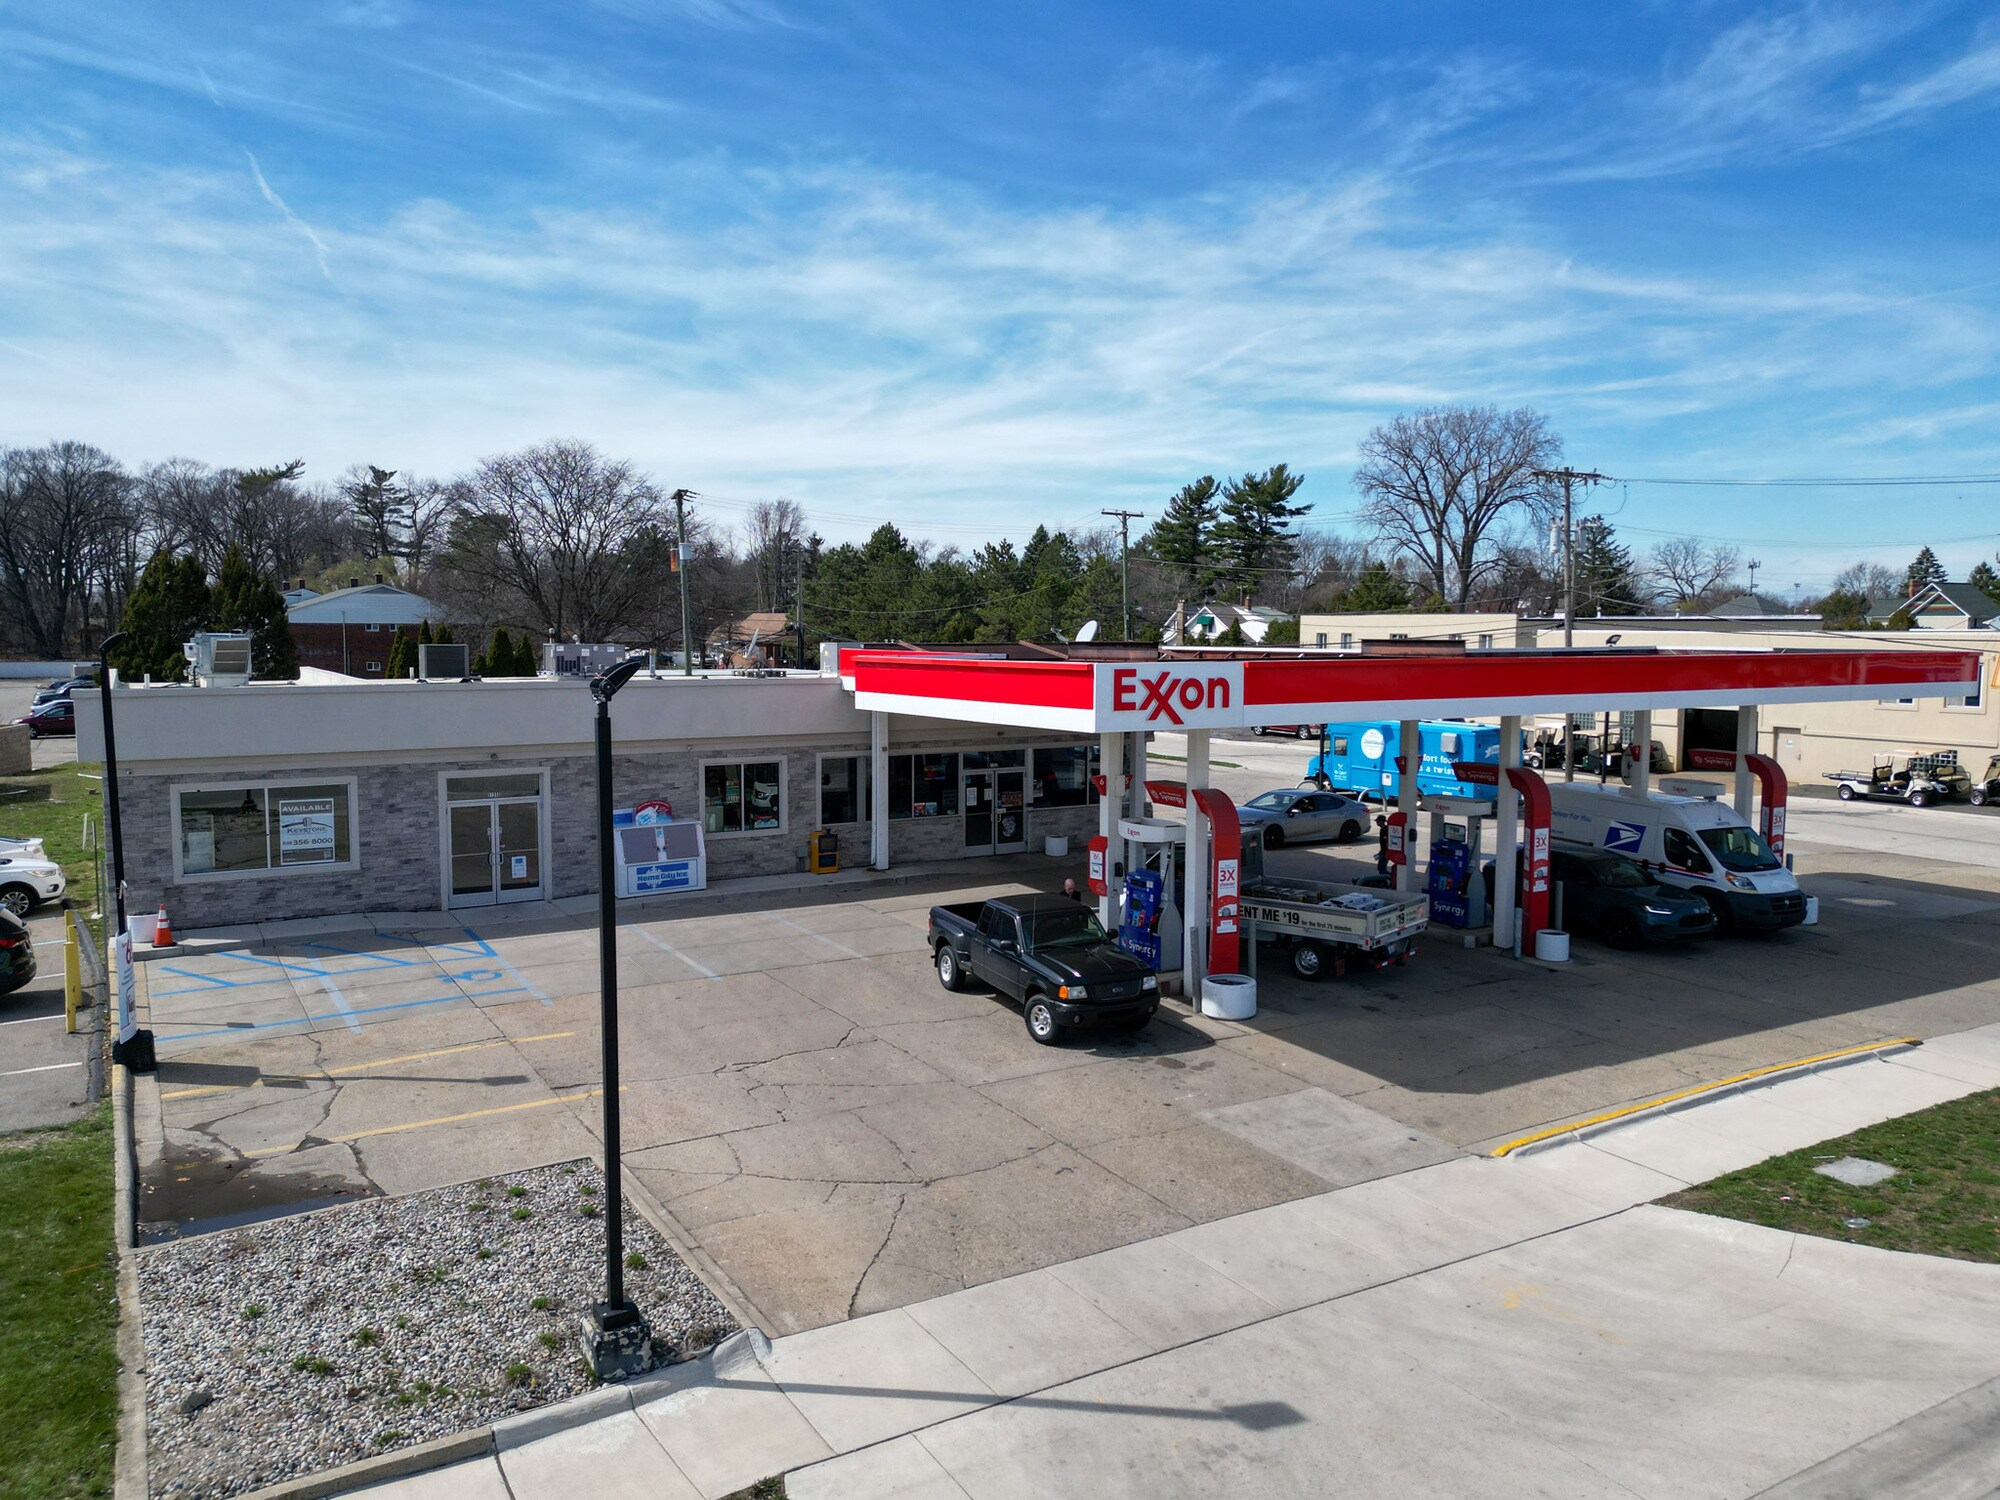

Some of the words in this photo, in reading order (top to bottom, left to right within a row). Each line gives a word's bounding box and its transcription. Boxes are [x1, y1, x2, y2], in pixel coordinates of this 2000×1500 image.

[1113, 668, 1230, 725] Exxon
[1422, 753, 1438, 763] fort
[1099, 777, 1105, 785] 6
[282, 804, 331, 812] AVAILABLE
[1773, 814, 1783, 825] 3X
[1127, 827, 1141, 837] Exxon
[1535, 836, 1547, 848] 3X
[638, 873, 660, 882] Home
[660, 872, 675, 880] City
[1219, 868, 1236, 882] 3X
[1239, 904, 1259, 920] ENT
[1261, 907, 1281, 923] ME
[1282, 911, 1300, 925] $19
[1128, 940, 1157, 958] Synergy
